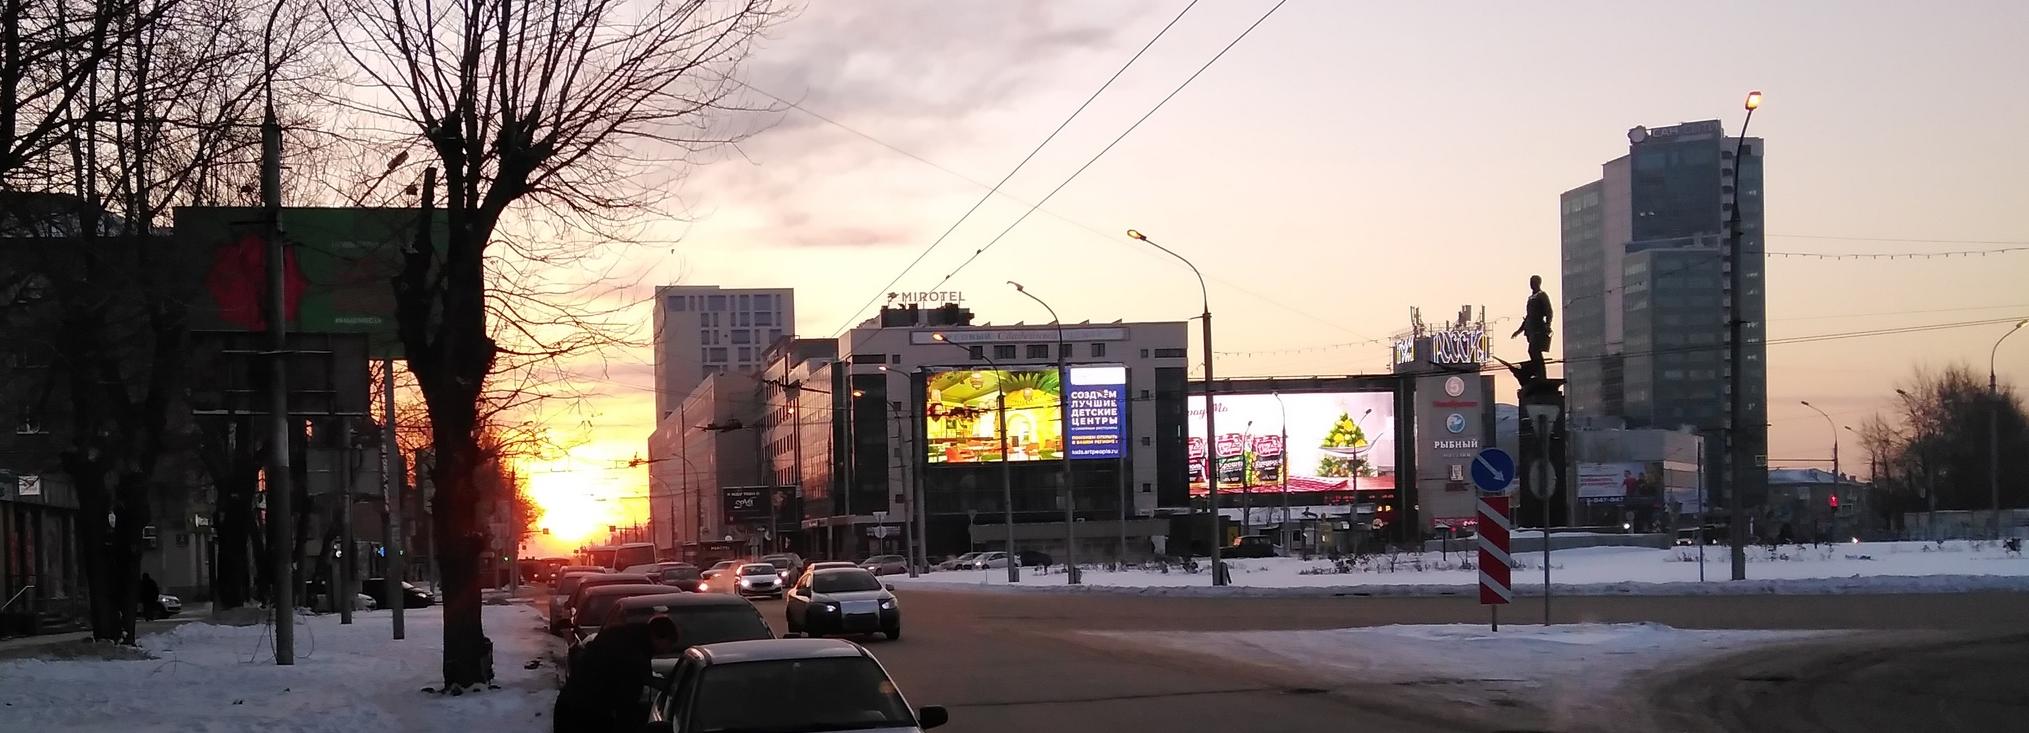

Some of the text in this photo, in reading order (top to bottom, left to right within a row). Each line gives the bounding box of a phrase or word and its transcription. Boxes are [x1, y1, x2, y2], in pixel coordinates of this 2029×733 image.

[902, 291, 965, 302] MIROTEL
[1433, 329, 1488, 364] РОССИЯ
[1071, 400, 1117, 408] ЛУЧШИЕ
[1071, 408, 1118, 418] ДЕТСКИЕ
[1071, 417, 1118, 426] ЦЕНТРЫ
[1434, 438, 1478, 449] РЫБНЫЙ
